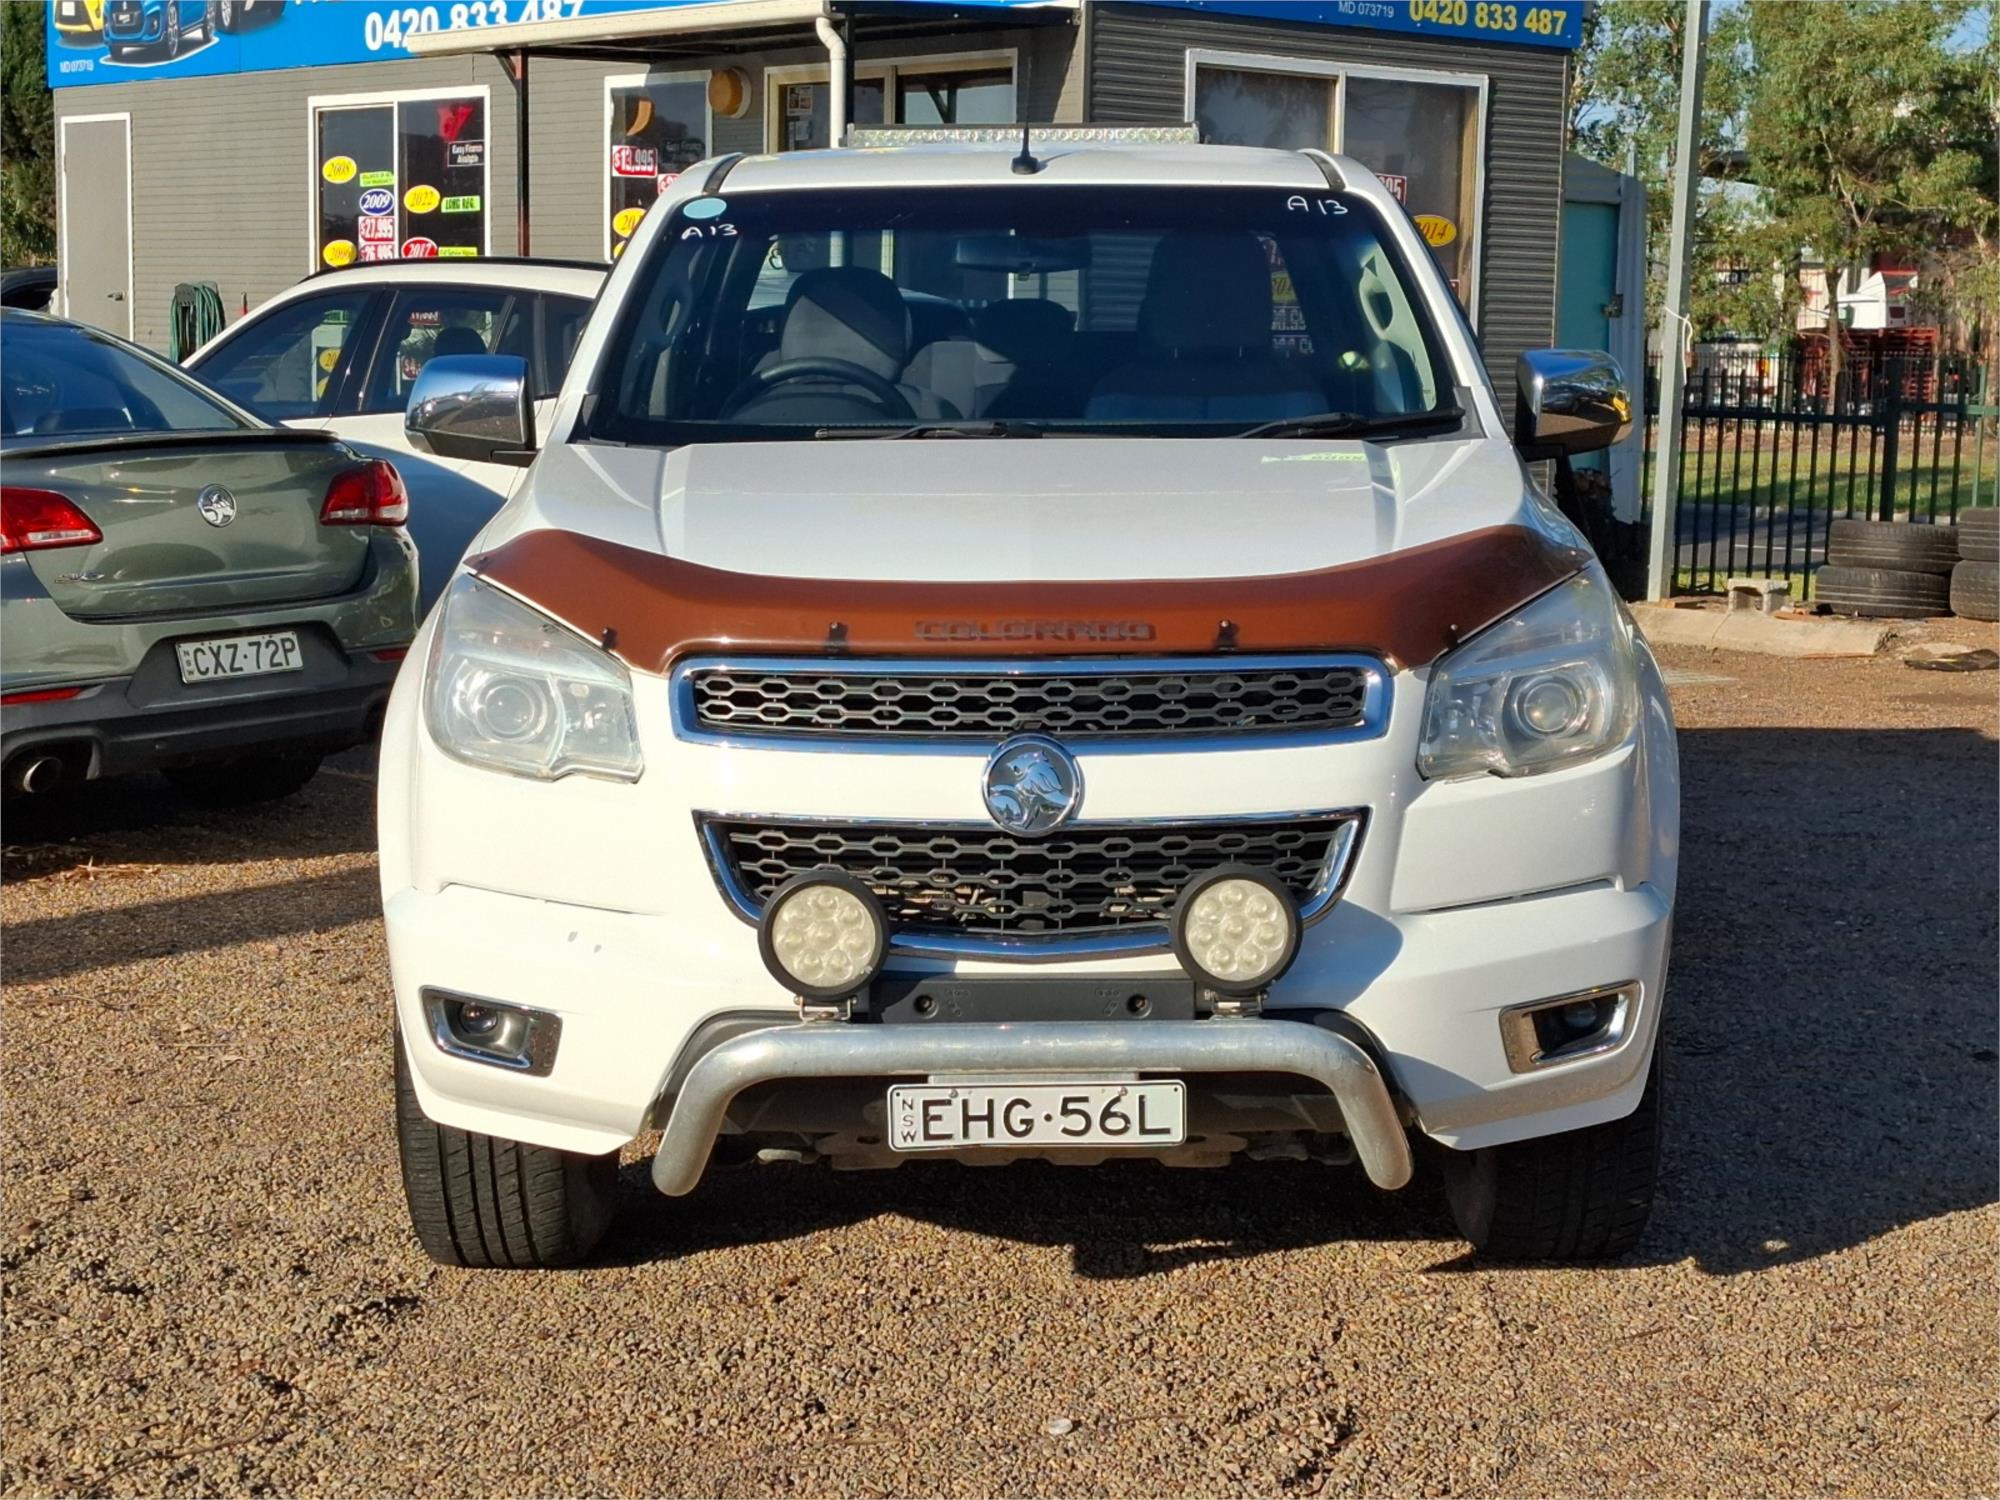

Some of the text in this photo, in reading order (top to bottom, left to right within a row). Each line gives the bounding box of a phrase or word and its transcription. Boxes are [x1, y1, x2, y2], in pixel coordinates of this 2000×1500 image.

[1338, 3, 1395, 18] MD 073719
[1409, 0, 1568, 36] 0420 833 487
[364, 6, 439, 51] 0420
[450, 0, 508, 29] 833
[614, 148, 654, 173] $13,995
[363, 193, 391, 209] 2009
[360, 218, 393, 240] $27,995
[360, 244, 393, 262] $26995
[407, 242, 433, 257] 2017
[915, 619, 1157, 642] COLORADO
